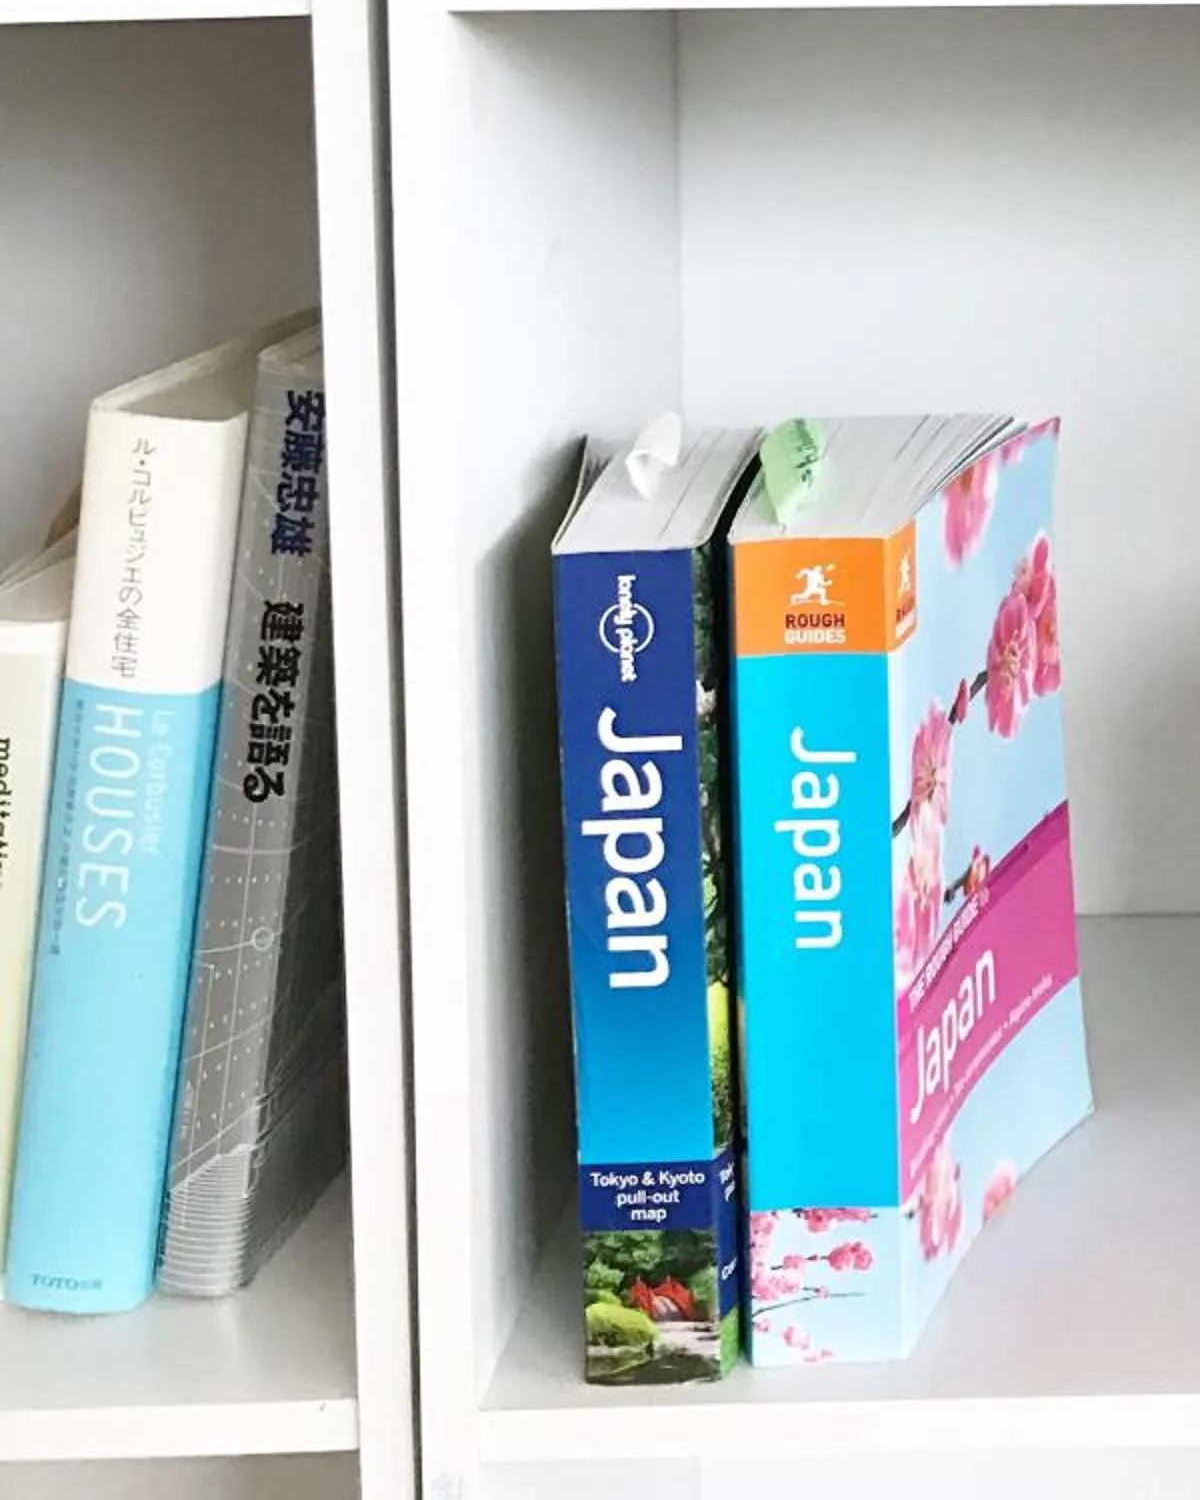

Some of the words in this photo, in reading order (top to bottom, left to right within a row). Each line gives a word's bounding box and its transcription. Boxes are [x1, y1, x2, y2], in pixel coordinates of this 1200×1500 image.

[614, 575, 638, 625] lonely
[785, 613, 845, 629] ROUGH
[615, 627, 638, 682] planet
[784, 629, 847, 645] GUIDES
[150, 711, 176, 735] Le
[243, 599, 304, 802] 建築を語る
[75, 703, 145, 930] HOUSES
[141, 741, 173, 857] Corbusier
[582, 706, 683, 989] Japan
[776, 727, 857, 951] Japan
[910, 947, 996, 1123] Japan
[589, 1172, 639, 1189] Tokyo
[642, 1171, 655, 1185] &
[659, 1170, 705, 1189] Kyoto
[616, 1189, 680, 1208] pull-out
[631, 1208, 667, 1222] map
